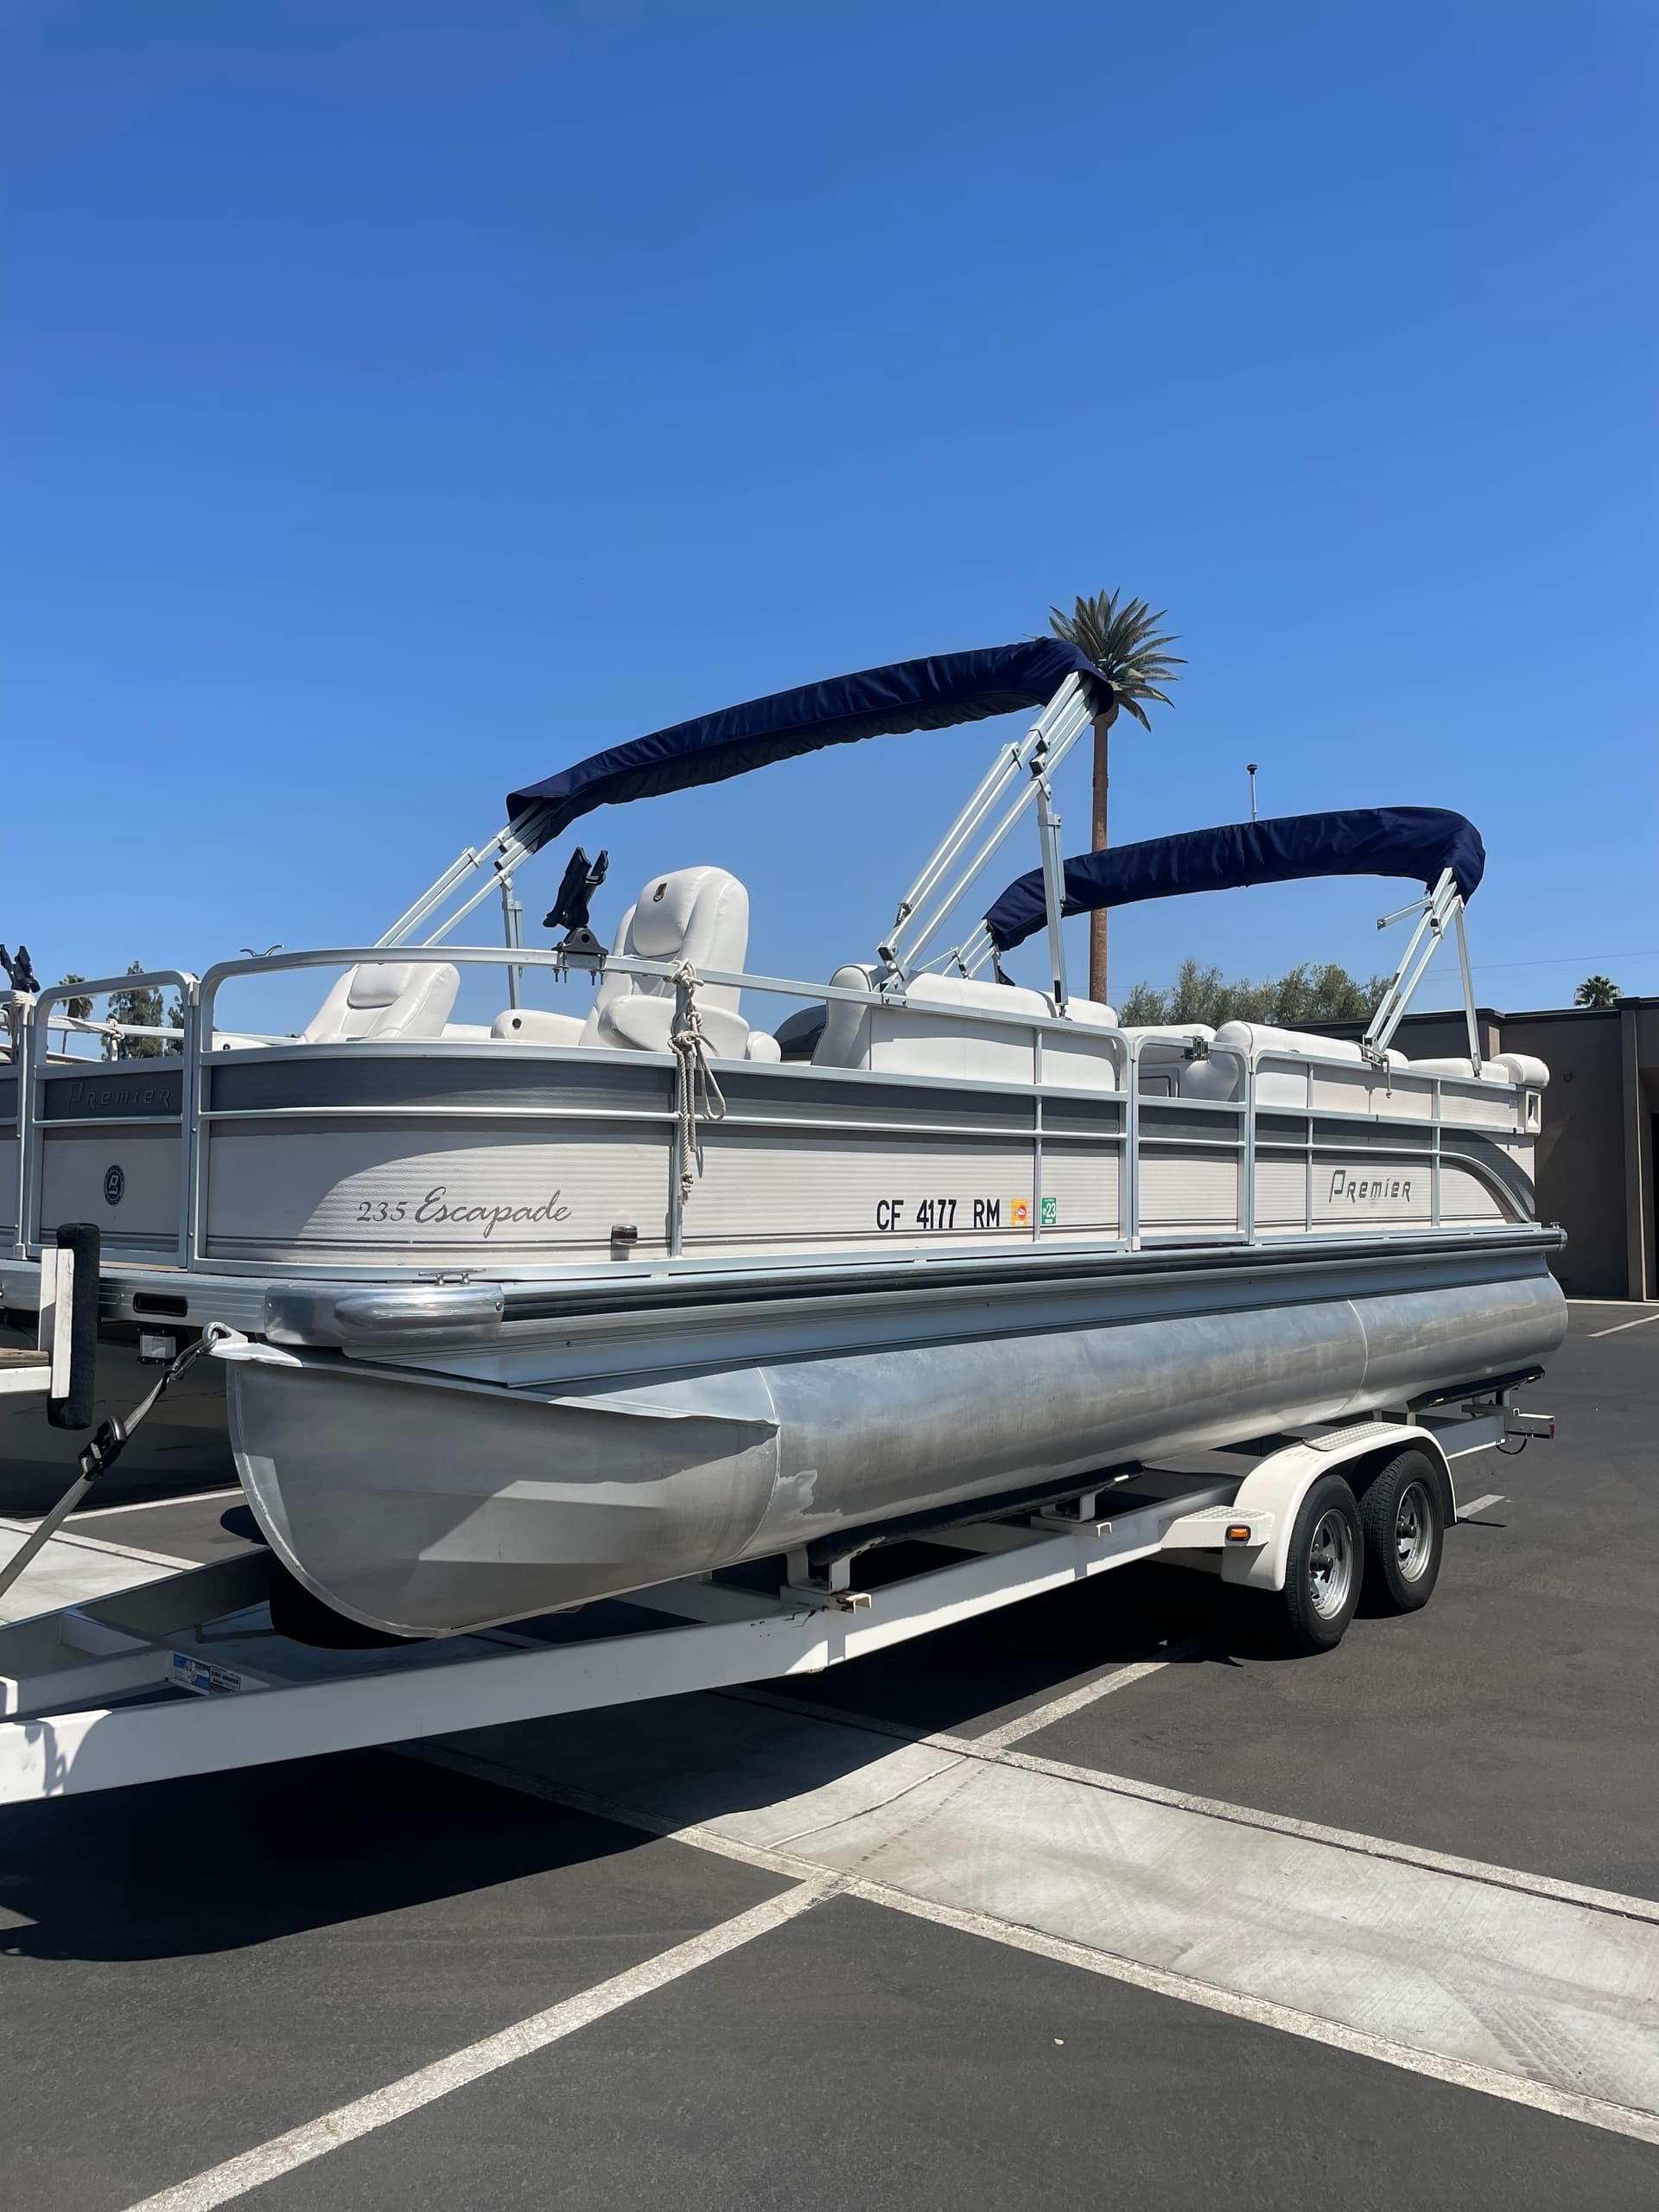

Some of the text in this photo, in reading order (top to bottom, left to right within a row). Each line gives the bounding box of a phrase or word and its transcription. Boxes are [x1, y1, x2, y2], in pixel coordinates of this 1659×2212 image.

[356, 1185, 572, 1238] 235 Escapade
[876, 1198, 1001, 1230] CF 4177 RM
[1046, 1202, 1056, 1218] 23
